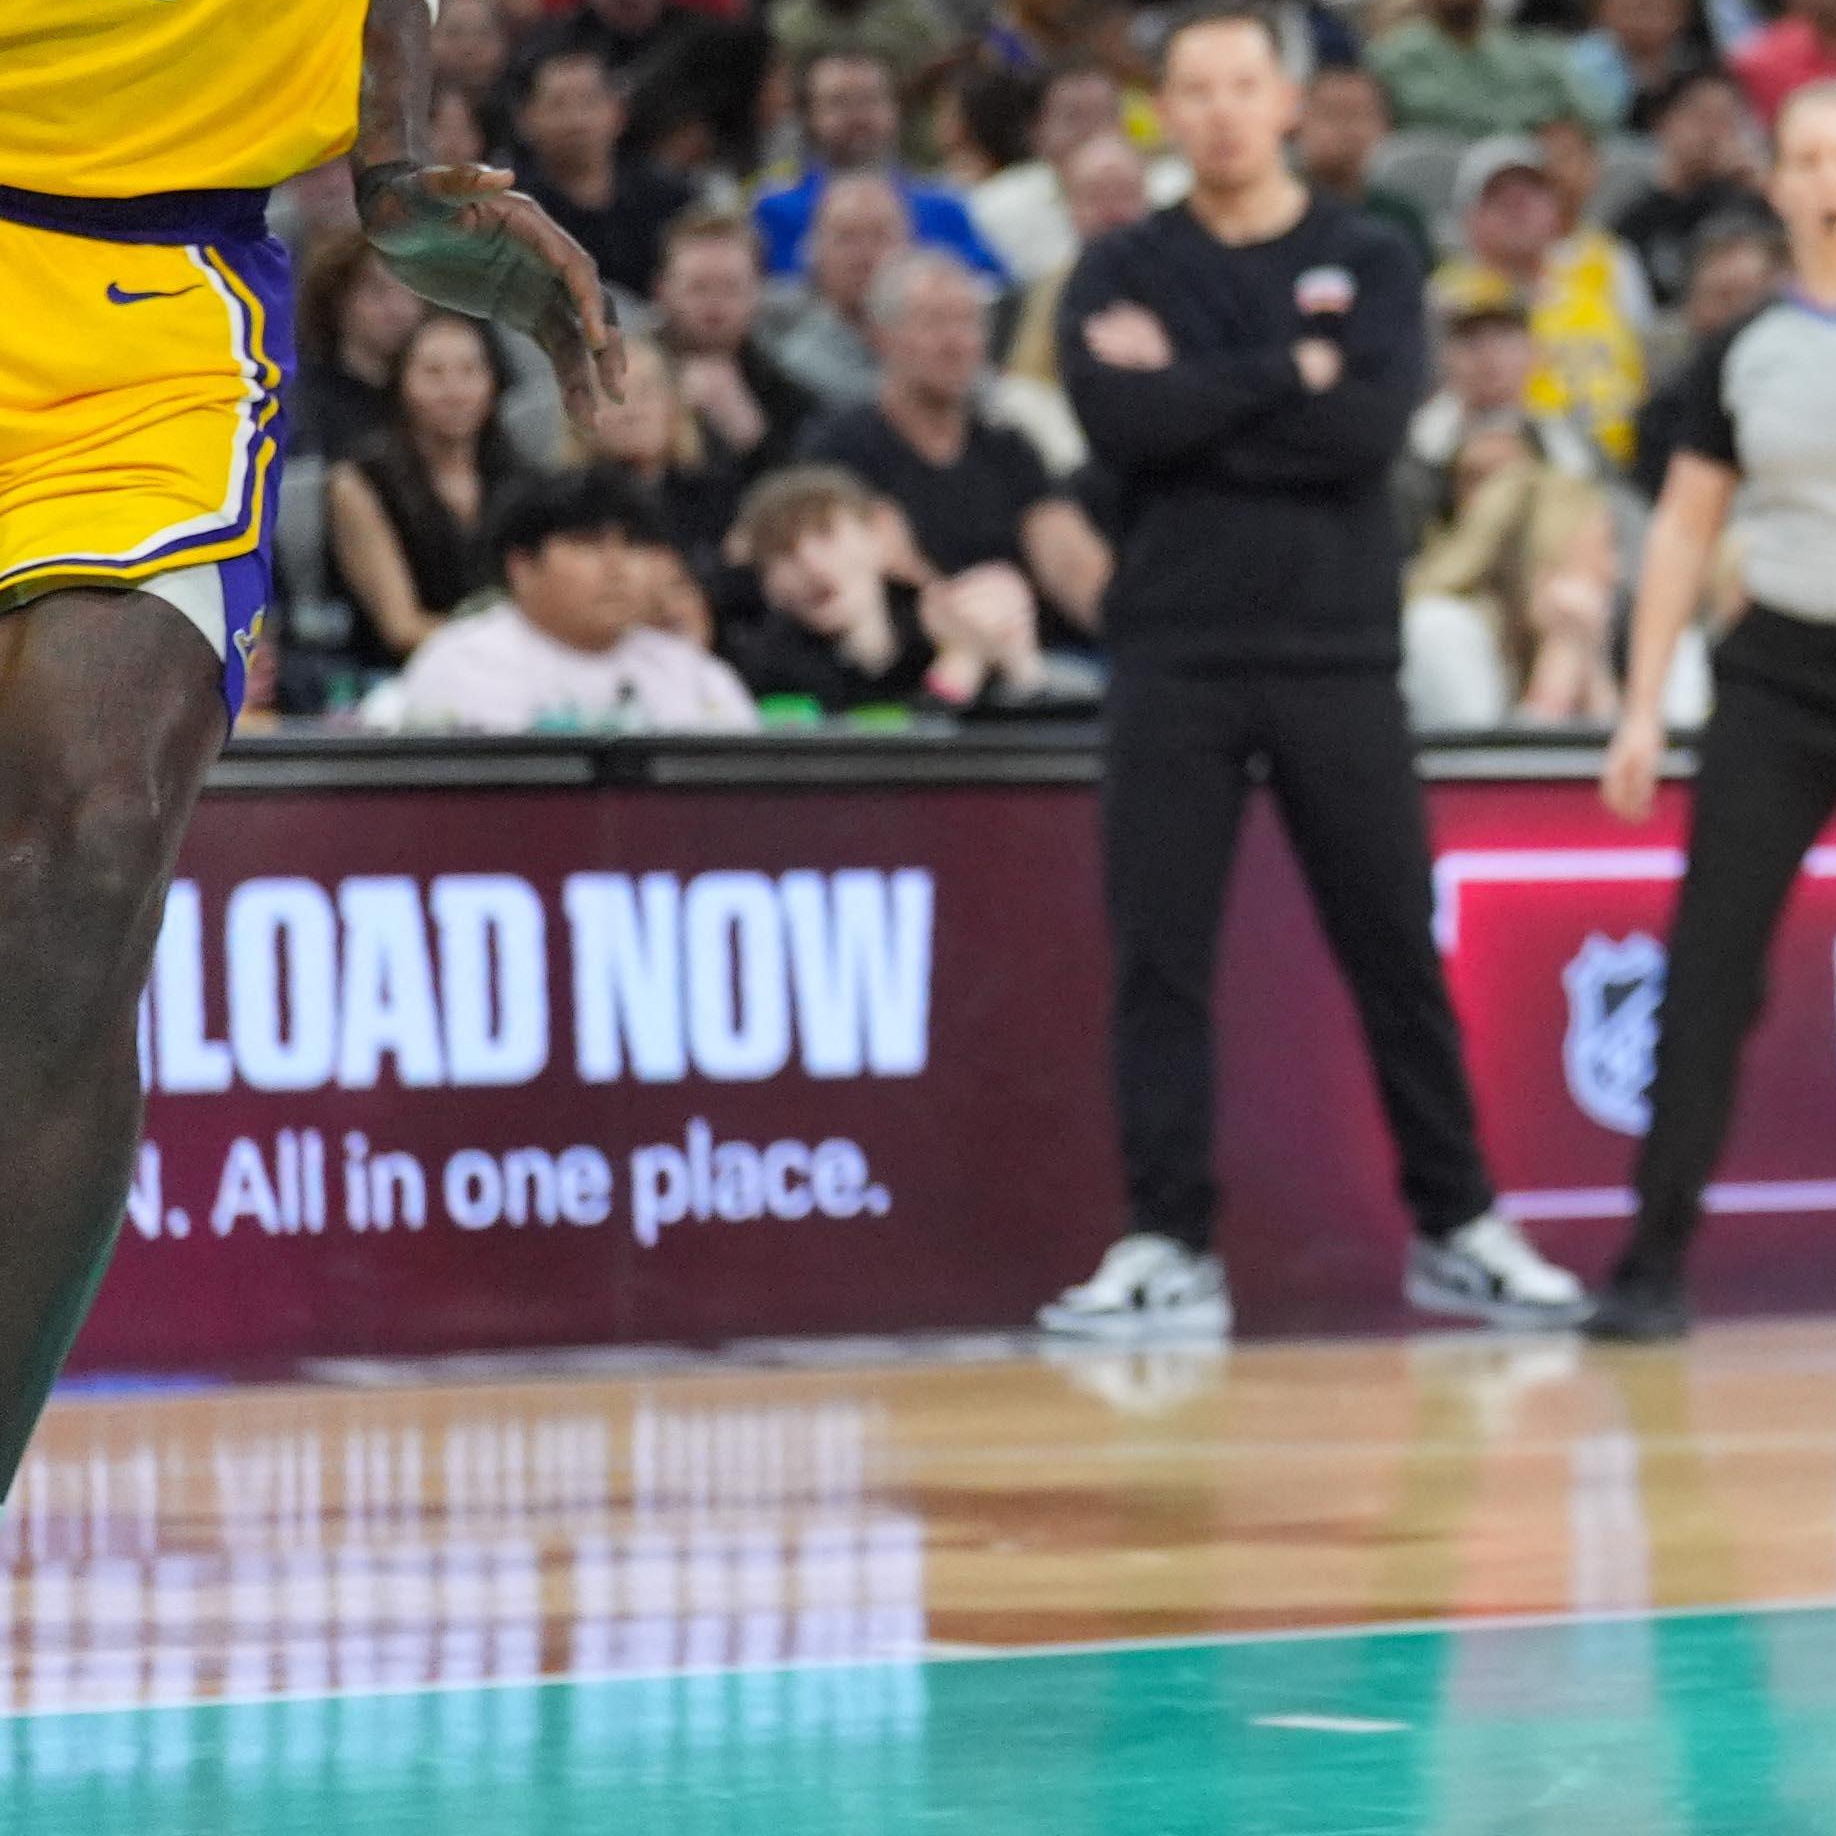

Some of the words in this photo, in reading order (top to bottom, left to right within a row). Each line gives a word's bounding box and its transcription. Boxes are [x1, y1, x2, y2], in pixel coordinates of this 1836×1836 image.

[138, 873, 550, 1092] LOAD
[563, 867, 935, 1084] NOW
[211, 1125, 327, 1238] All
[345, 1129, 427, 1234] in
[443, 1142, 612, 1231] one
[632, 1115, 893, 1248] place.
